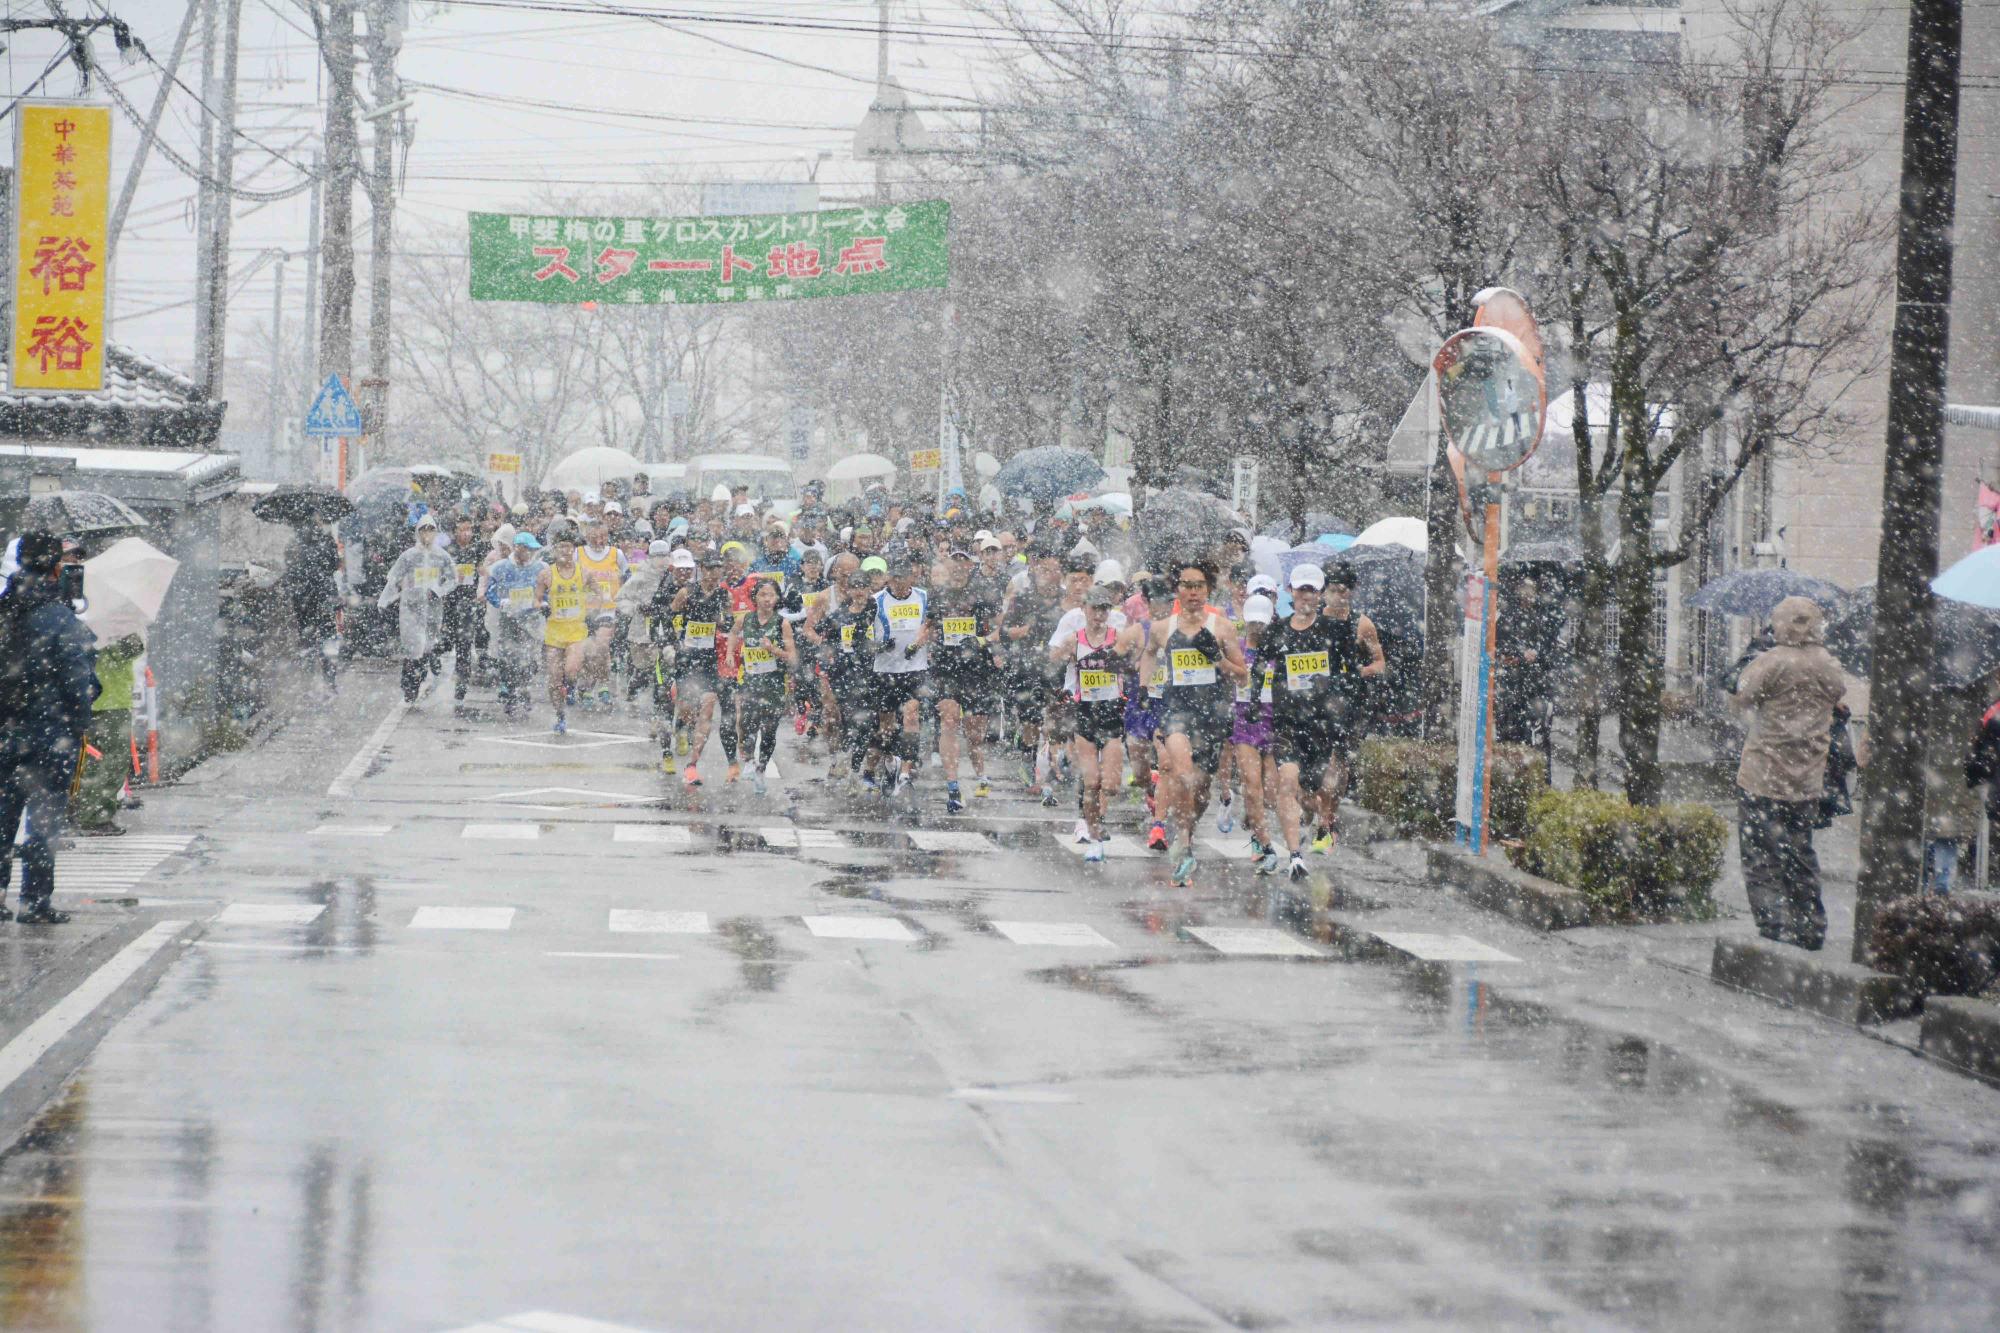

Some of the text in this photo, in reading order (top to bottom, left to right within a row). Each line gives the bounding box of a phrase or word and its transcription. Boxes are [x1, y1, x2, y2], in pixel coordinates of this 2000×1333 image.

[509, 204, 908, 245] 甲斐梅の里クロスカントリー大会
[532, 236, 891, 285] スタート地点
[946, 621, 967, 631] 5212
[1176, 652, 1204, 667] 5035
[1292, 657, 1319, 672] 5013
